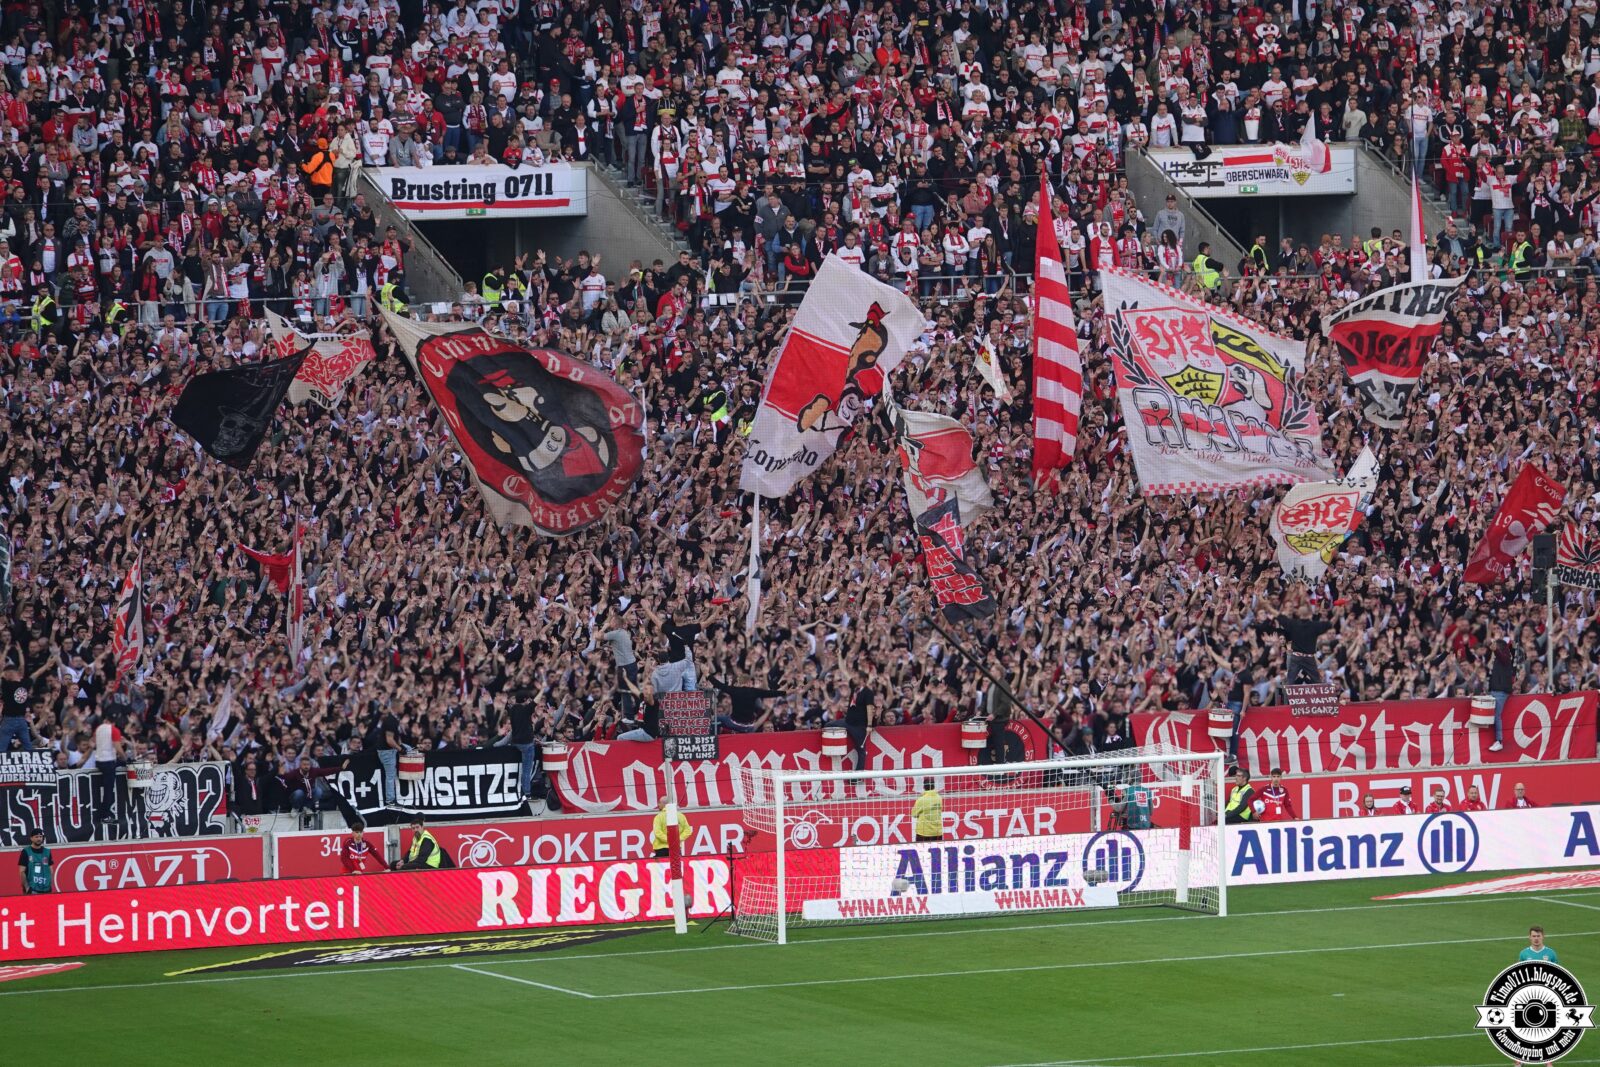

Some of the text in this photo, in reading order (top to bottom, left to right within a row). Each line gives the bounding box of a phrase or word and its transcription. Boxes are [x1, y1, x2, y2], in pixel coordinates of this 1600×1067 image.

[1226, 168, 1290, 183] OBERSCHWABEN
[391, 173, 553, 205] Brustring 0711
[609, 402, 637, 425] 97
[664, 691, 705, 700] JEDER
[1286, 686, 1336, 696] ULTRA IST
[1288, 698, 1308, 706] DER
[659, 698, 711, 710] VERBANNTE
[1311, 706, 1339, 715] GANZE
[677, 736, 716, 745] DU BIST
[677, 744, 716, 753] IMMER
[1144, 696, 1586, 782] Cnnstatt 97
[0, 751, 53, 765] LTRAS
[695, 751, 716, 759] UNS!
[0, 764, 54, 774] EDEUTET
[832, 806, 1058, 847] JOKRSTAR
[320, 835, 343, 857] 34
[514, 823, 745, 866] JOKERAR
[1231, 824, 1404, 878] Allianz
[890, 844, 1069, 897] Allianz
[477, 858, 733, 928] RIEGER
[994, 888, 1086, 911] WINAMAX
[58, 884, 361, 947] Heimvorteil
[837, 896, 930, 918] WINAMAX
